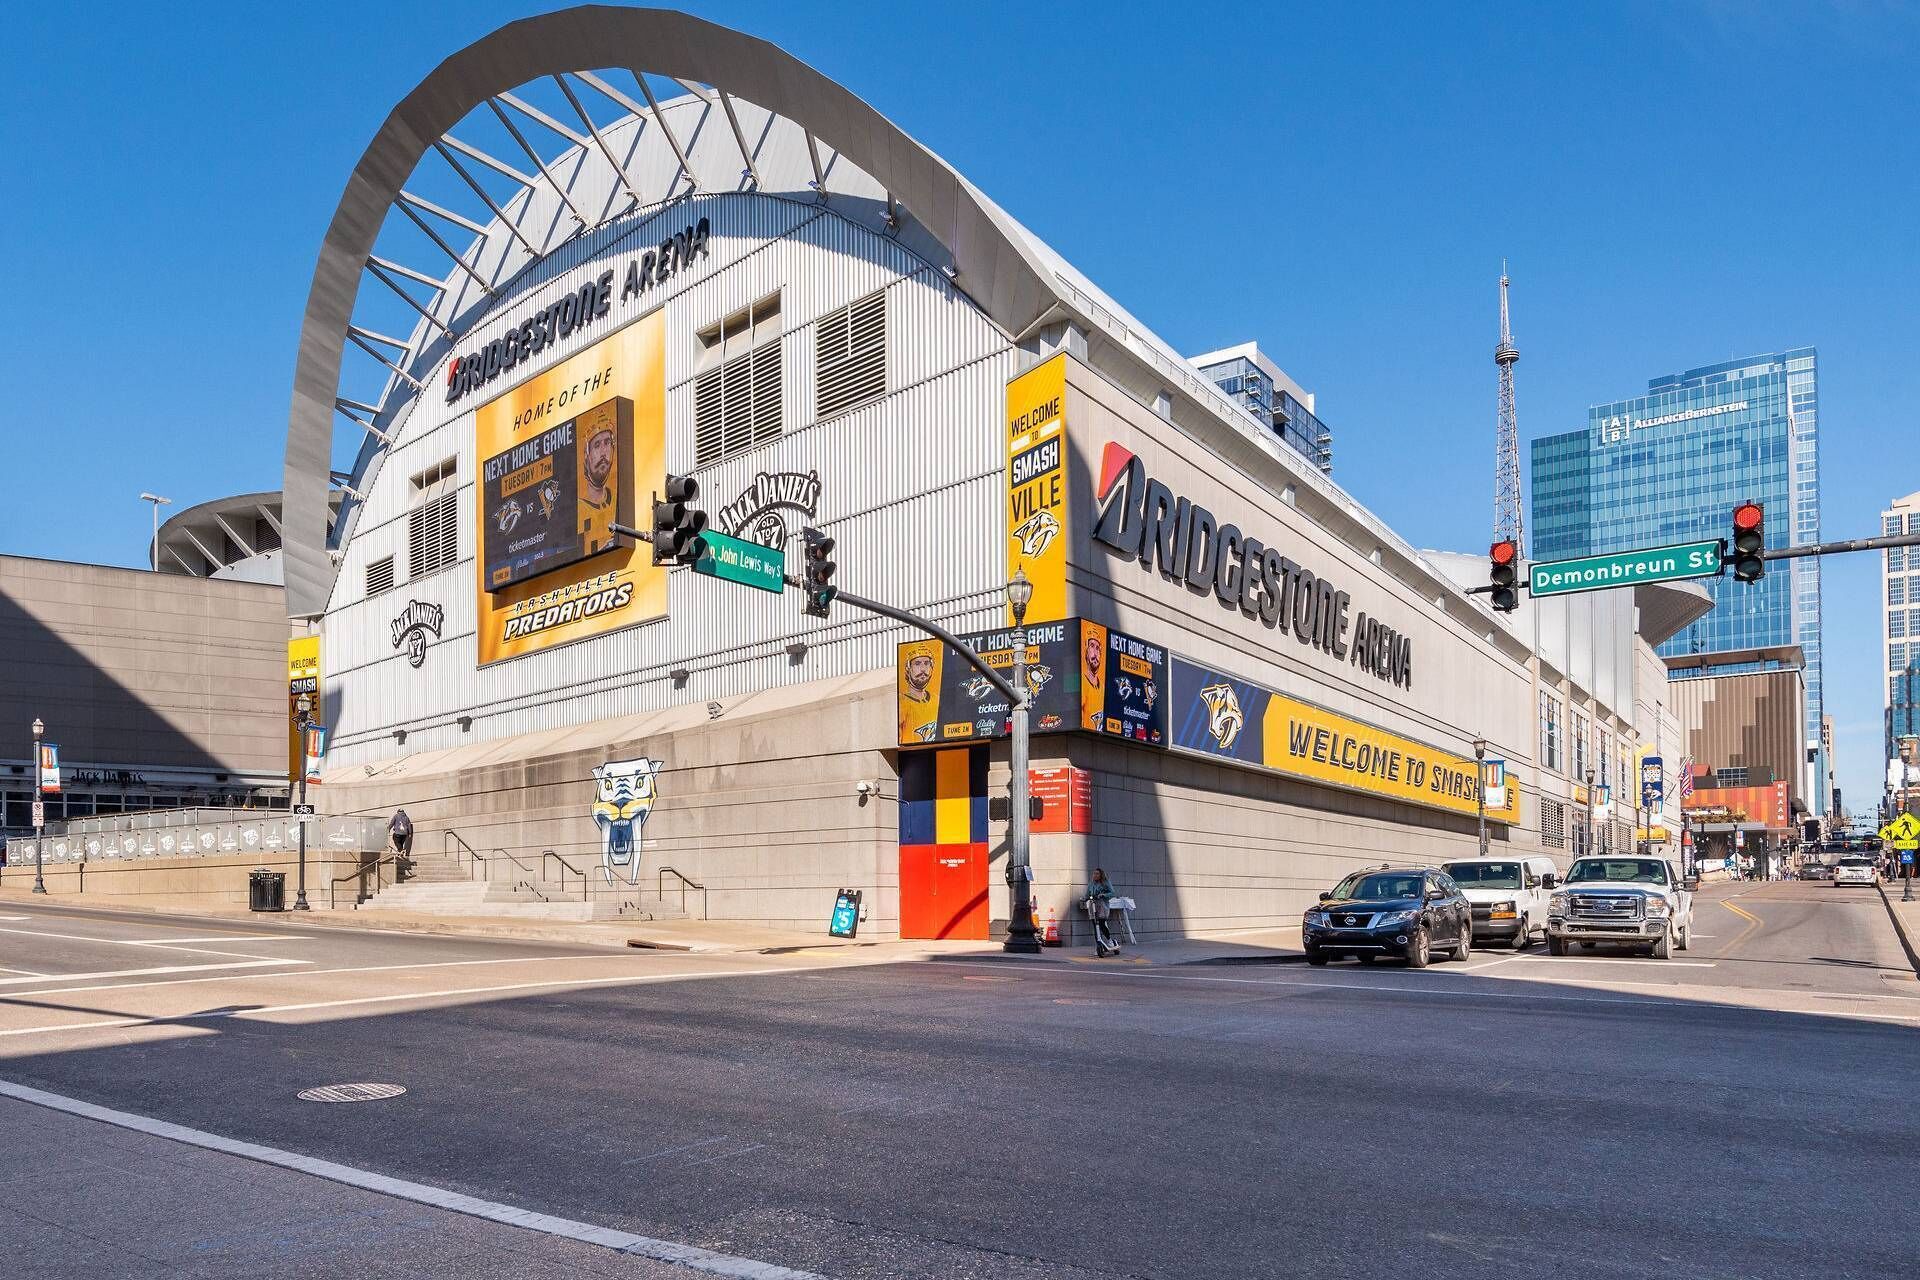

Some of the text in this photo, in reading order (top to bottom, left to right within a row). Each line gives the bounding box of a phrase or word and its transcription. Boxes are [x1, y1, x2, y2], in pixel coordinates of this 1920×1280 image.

[445, 217, 711, 403] BRIDGESTONE ARENA
[513, 367, 612, 431] HOME OF THE
[1011, 397, 1060, 437] WELCOME
[485, 423, 573, 482] NEXT HOME GAME
[1031, 430, 1039, 442] TO
[504, 466, 535, 492] TUESDAY
[1012, 440, 1058, 485] SMASH
[719, 486, 757, 537] JACK
[1011, 474, 1061, 523] VILLE
[761, 518, 775, 528] OLD
[508, 532, 547, 553] ticketmaster
[717, 545, 738, 566] John
[740, 551, 762, 573] Lewis
[764, 561, 775, 579] Way
[777, 565, 781, 577] S
[1093, 441, 1412, 691] BRIDGESTONE ARENA
[1537, 551, 1714, 588] Demonbreun St
[513, 571, 618, 614] NASHVILLE
[503, 582, 634, 641] PREDATORS
[1027, 625, 1065, 646] GAME
[1110, 633, 1162, 665] NEXT HOME GAME
[291, 656, 317, 670] WELCOME
[291, 678, 316, 693] SMASH
[1289, 716, 1401, 782] WELCOME
[1405, 756, 1426, 788] TO
[71, 768, 100, 784] JACK
[1777, 783, 1785, 820] NMAAM
